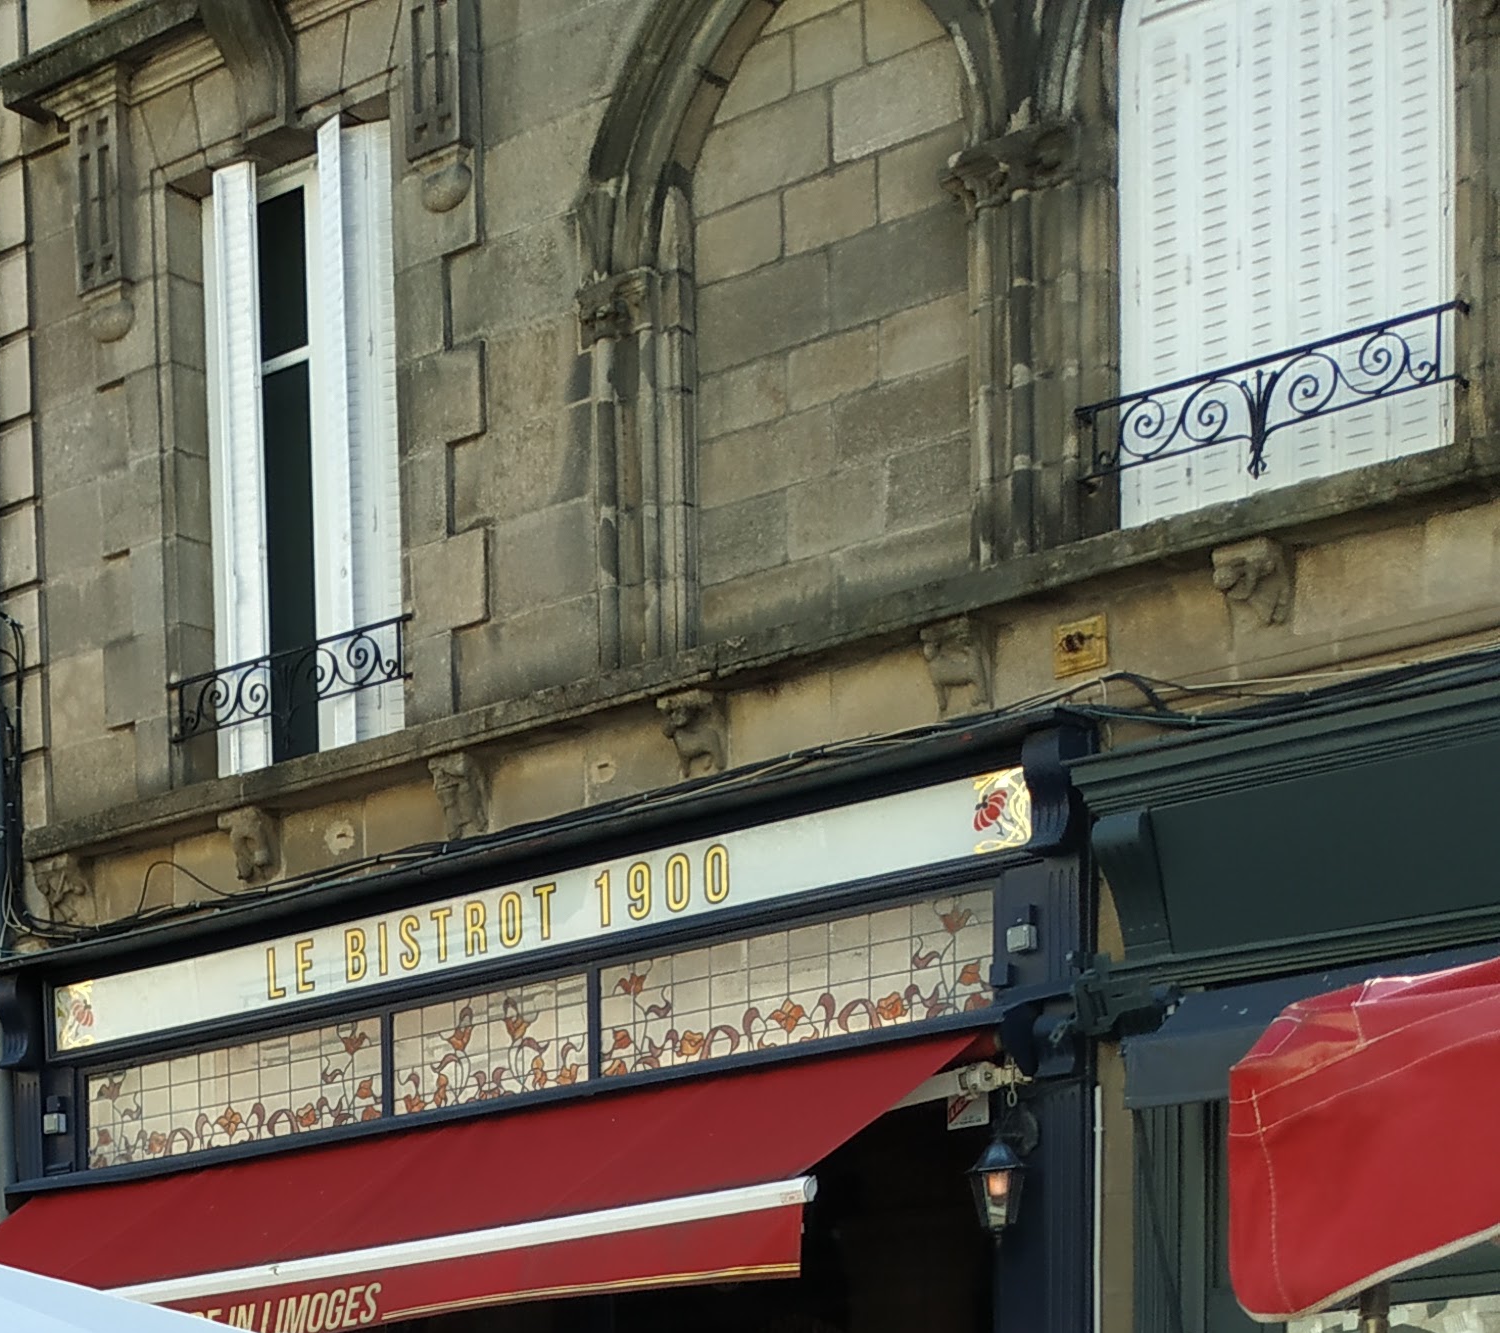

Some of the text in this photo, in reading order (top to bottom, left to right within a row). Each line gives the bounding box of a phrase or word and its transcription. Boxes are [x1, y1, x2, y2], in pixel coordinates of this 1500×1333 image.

[266, 843, 730, 1000] LE BISTROT 1900
